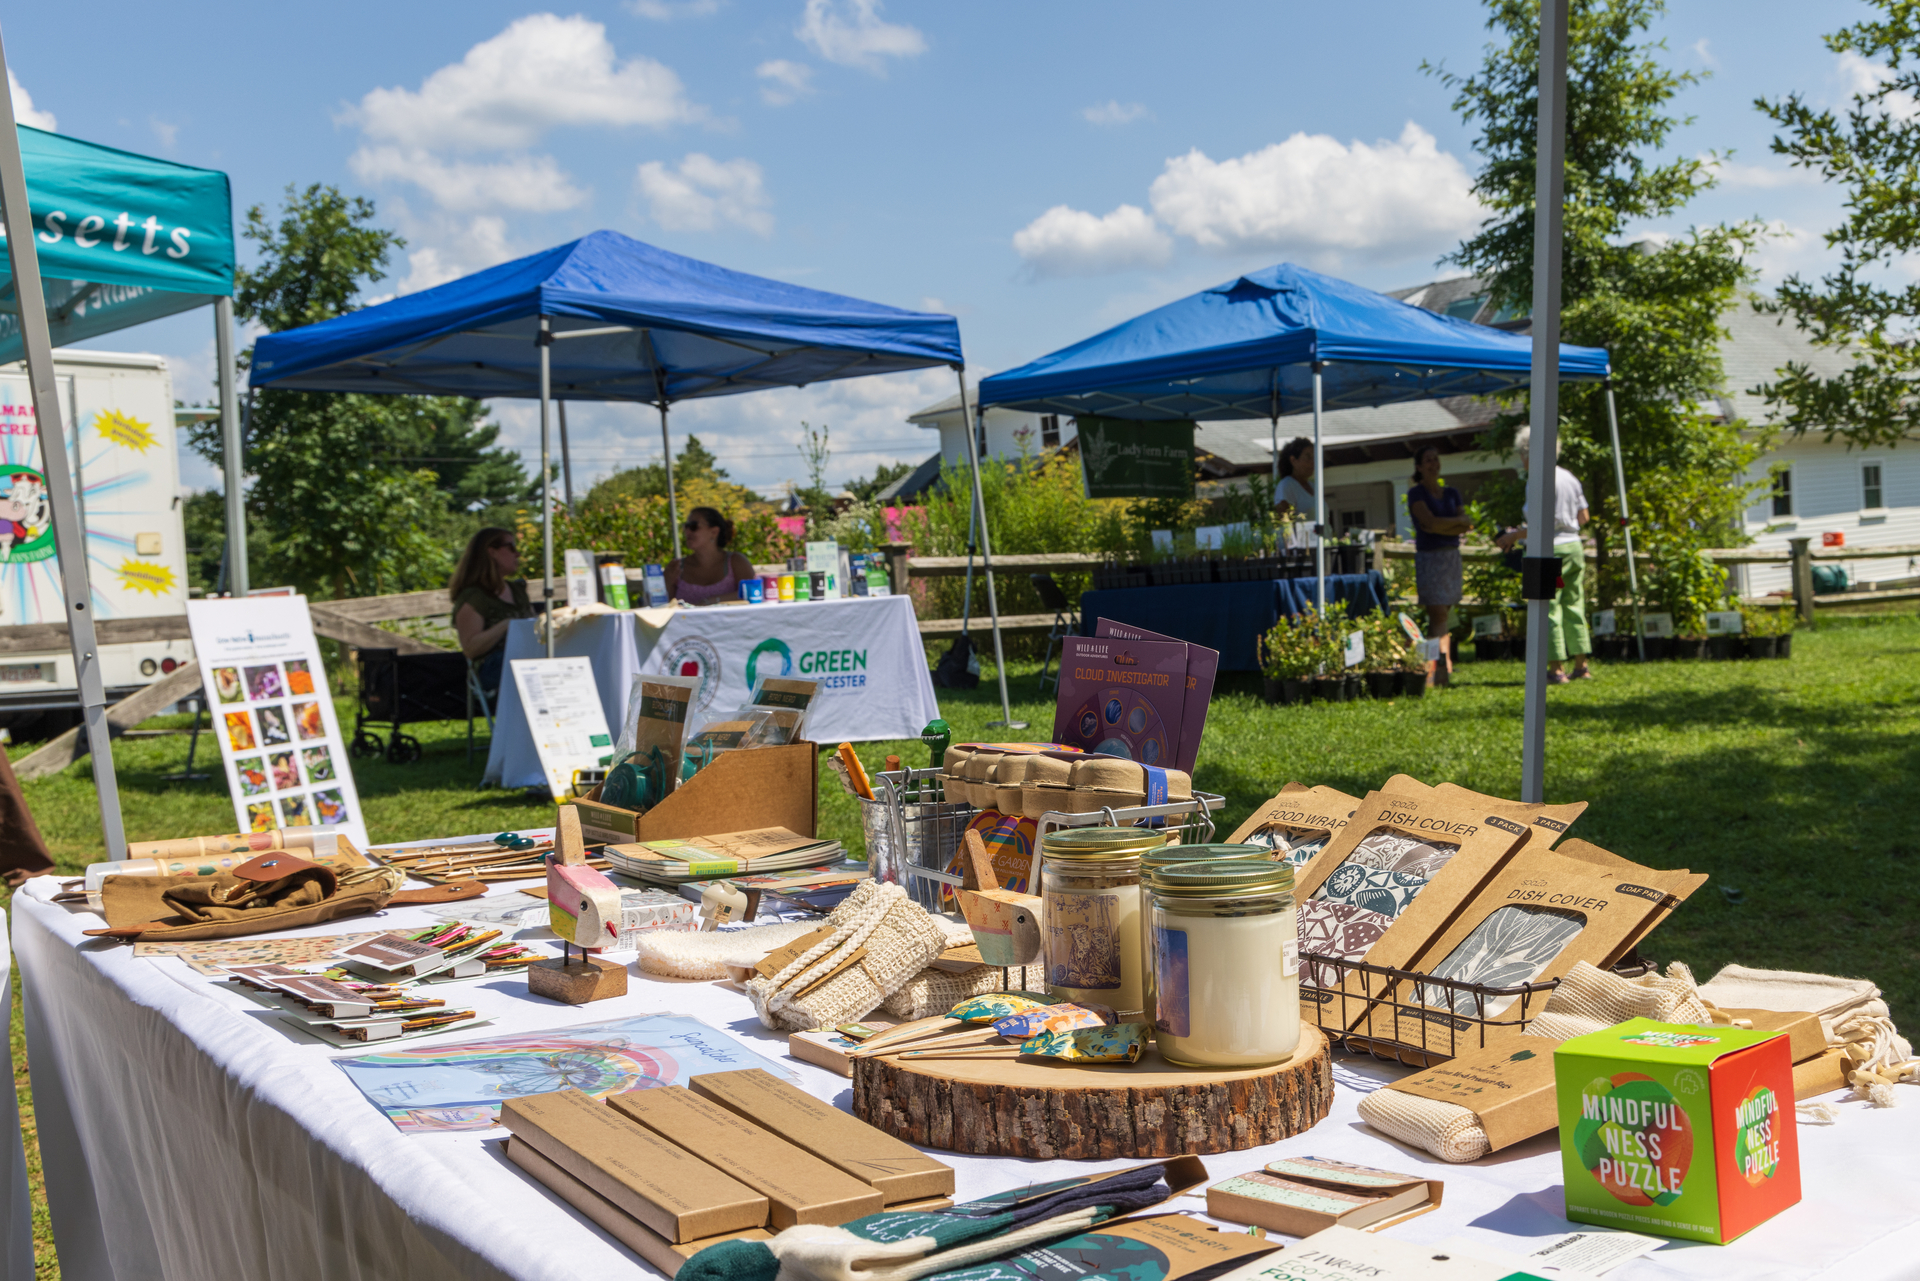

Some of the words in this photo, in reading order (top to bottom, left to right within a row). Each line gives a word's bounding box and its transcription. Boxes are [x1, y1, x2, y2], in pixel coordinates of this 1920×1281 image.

[1076, 643, 1090, 652] WILD
[1095, 644, 1109, 654] LIFE
[799, 649, 868, 674] GREEN
[1075, 668, 1104, 681] CLOUD
[1106, 669, 1170, 686] INVESTIGATOR
[1265, 810, 1304, 821] FOOD
[1377, 810, 1419, 827] DISH
[1419, 818, 1479, 837] COVER
[1497, 821, 1521, 833] PACK
[1540, 820, 1563, 831] PACK
[998, 855, 1031, 871] GARDEN
[1506, 889, 1548, 901] DISH
[1549, 893, 1609, 912] COVER
[1620, 885, 1642, 895] LOAF
[1642, 890, 1661, 900] PAN
[1582, 1094, 1683, 1131] MINDFUL
[1735, 1091, 1778, 1130] MINDFUL
[1605, 1129, 1662, 1160] NESS
[1747, 1120, 1772, 1149] NESS
[1745, 1141, 1780, 1178] PUZZLE
[1244, 1173, 1265, 1181] GO
[1268, 1179, 1299, 1190] FOR
[1599, 1157, 1683, 1195] PUZZLE
[1569, 1205, 1590, 1214] SEPARATE
[1599, 1209, 1618, 1218] WOODEN
[1618, 1212, 1635, 1220] PUZZLE
[1635, 1215, 1650, 1224] PIECES
[1661, 1219, 1672, 1227] FIND
[1677, 1222, 1692, 1230] SENSE
[1699, 1225, 1714, 1234] PEACE
[1141, 1219, 1182, 1235] HAPPY
[1189, 1234, 1234, 1252] EARTH
